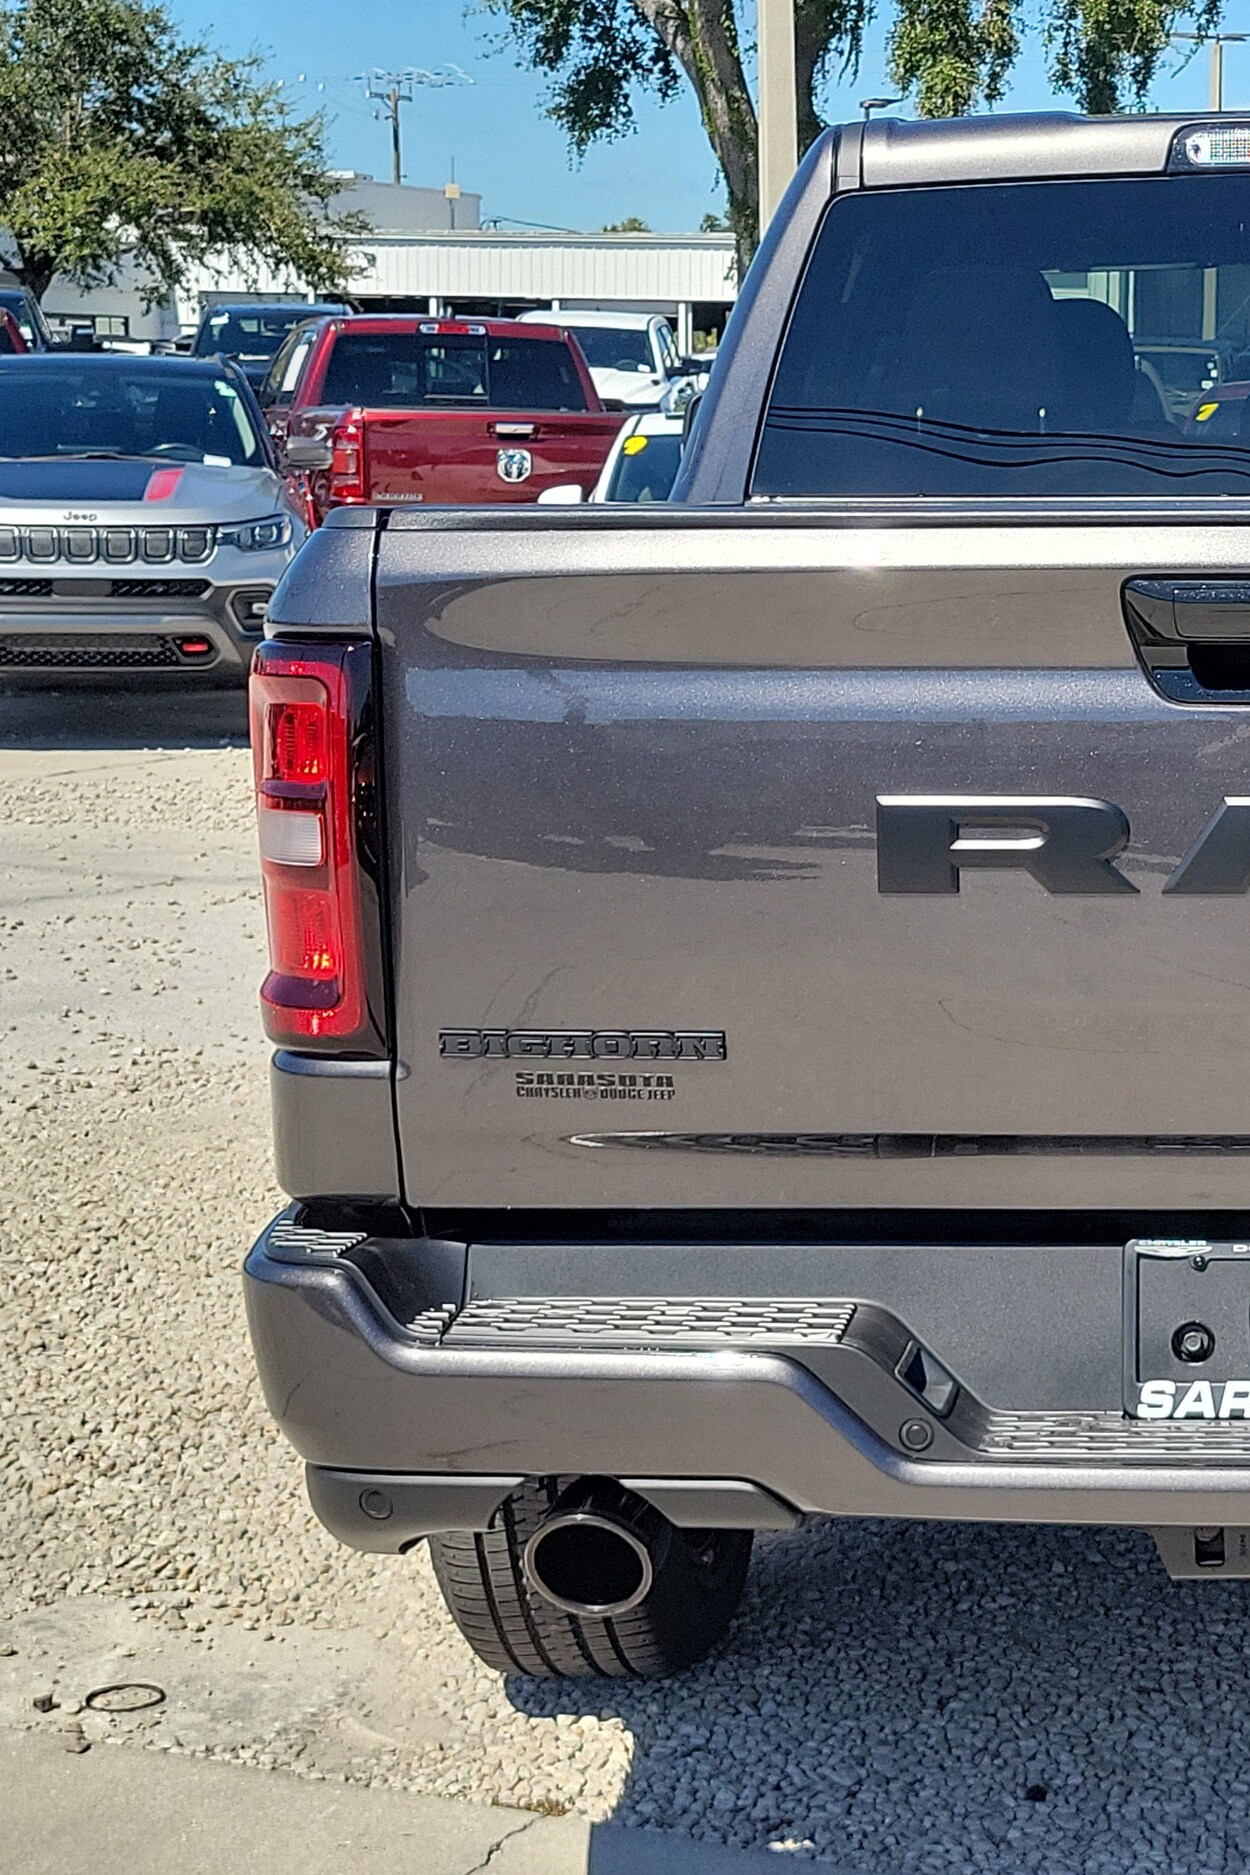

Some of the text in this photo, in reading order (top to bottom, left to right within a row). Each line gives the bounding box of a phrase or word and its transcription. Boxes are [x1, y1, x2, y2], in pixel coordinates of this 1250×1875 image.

[63, 510, 97, 522] Jeep
[439, 1028, 727, 1060] BIGHORN
[515, 1072, 674, 1088] SARASOTA
